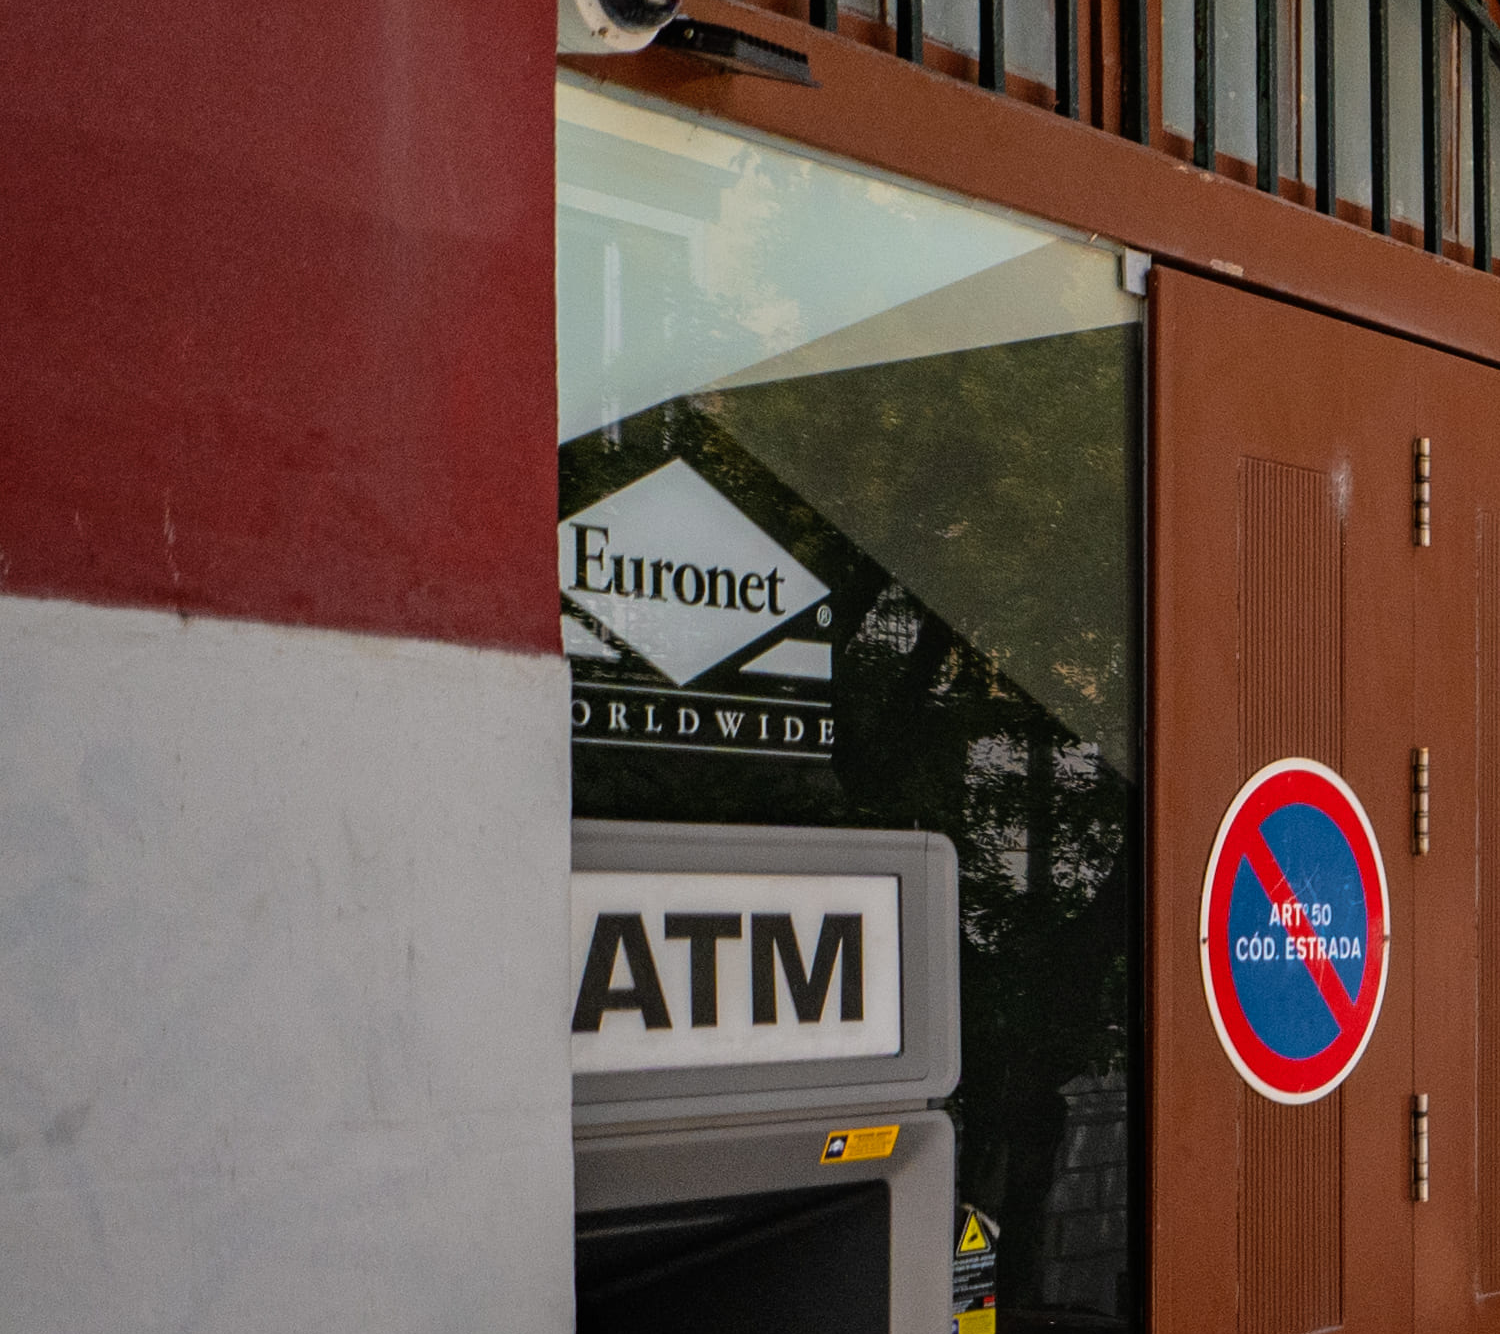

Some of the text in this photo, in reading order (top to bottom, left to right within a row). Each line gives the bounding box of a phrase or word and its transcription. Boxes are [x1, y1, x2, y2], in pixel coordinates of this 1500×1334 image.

[568, 521, 786, 616] Euronet
[571, 699, 835, 745] ORLDWIDE
[1311, 903, 1333, 926] 50
[1235, 931, 1362, 961] CÓD. ESTRADA
[571, 912, 864, 1033] ATM
